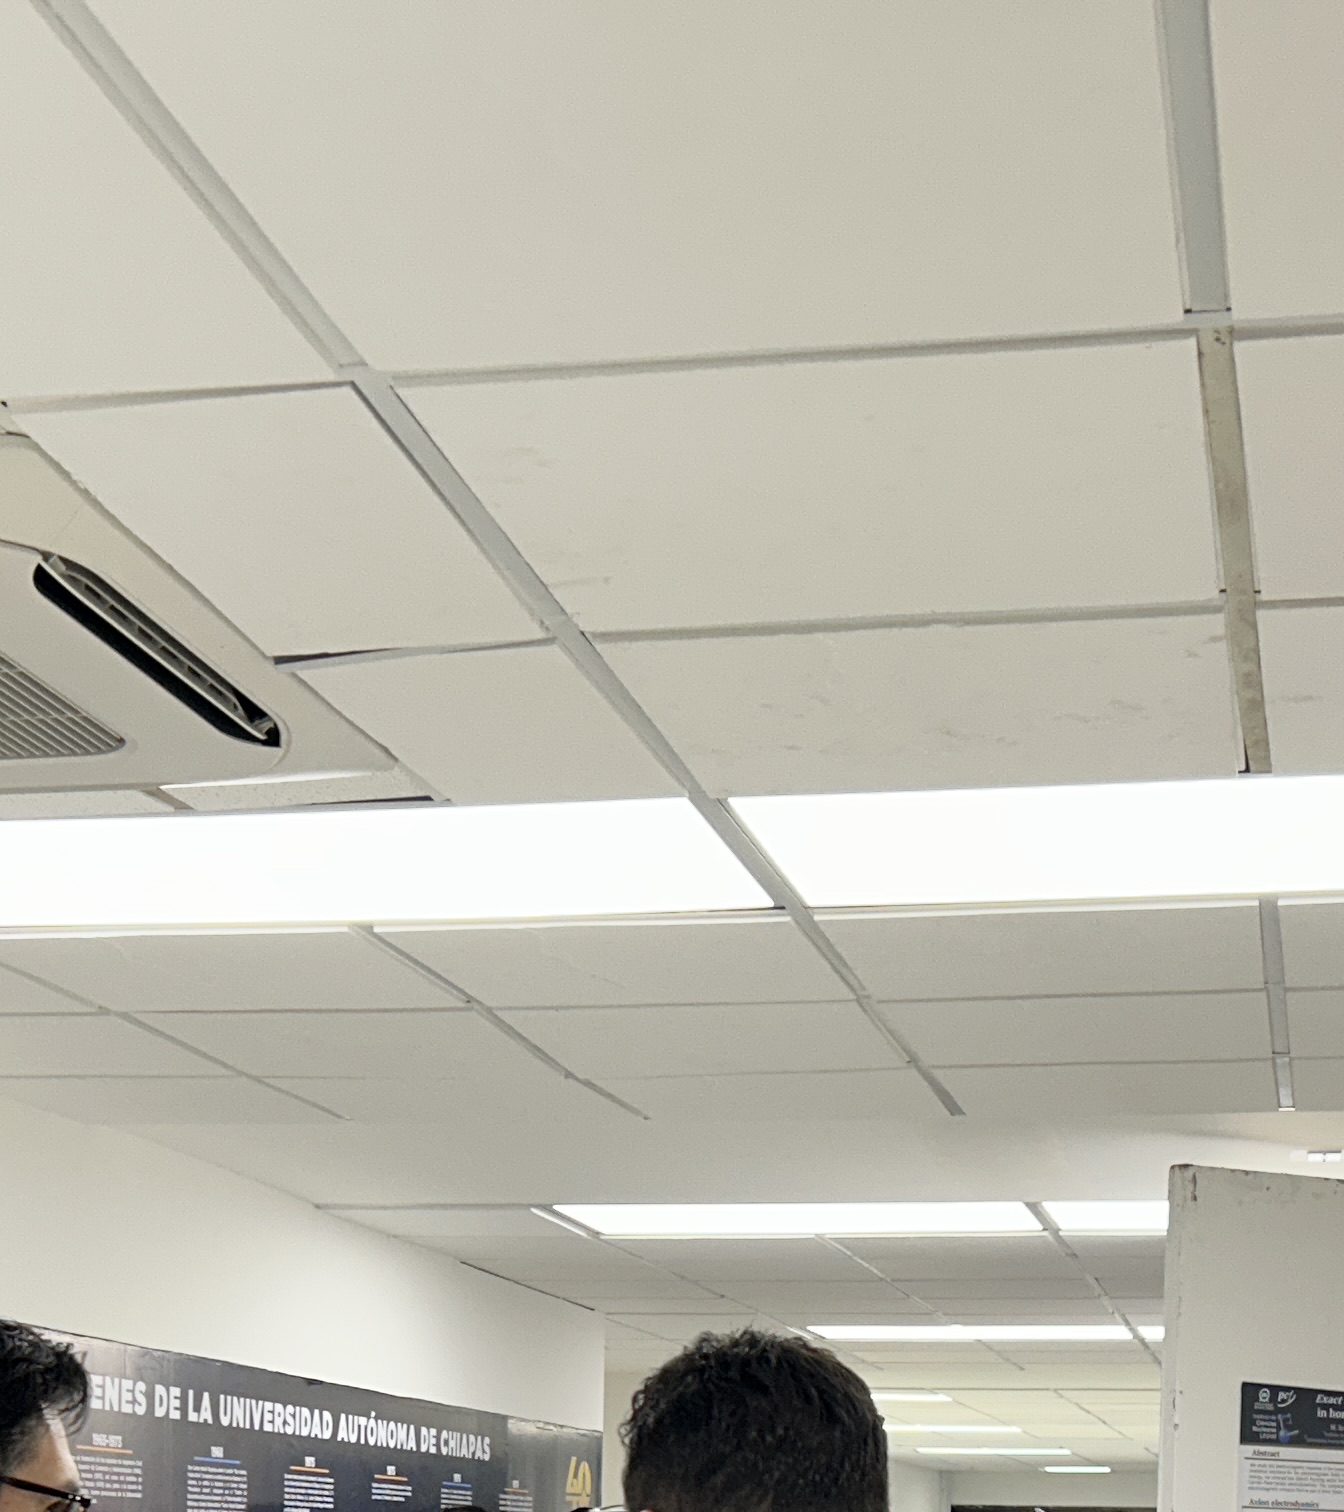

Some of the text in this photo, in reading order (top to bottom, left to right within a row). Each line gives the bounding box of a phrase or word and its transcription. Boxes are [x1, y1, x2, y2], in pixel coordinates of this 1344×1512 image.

[1316, 1394, 1342, 1405] Exact
[90, 1374, 491, 1461] ENES DE LA UNIVERSIDAD AUTÓNOMA DE CHIAPAS
[1317, 1407, 1327, 1417] in
